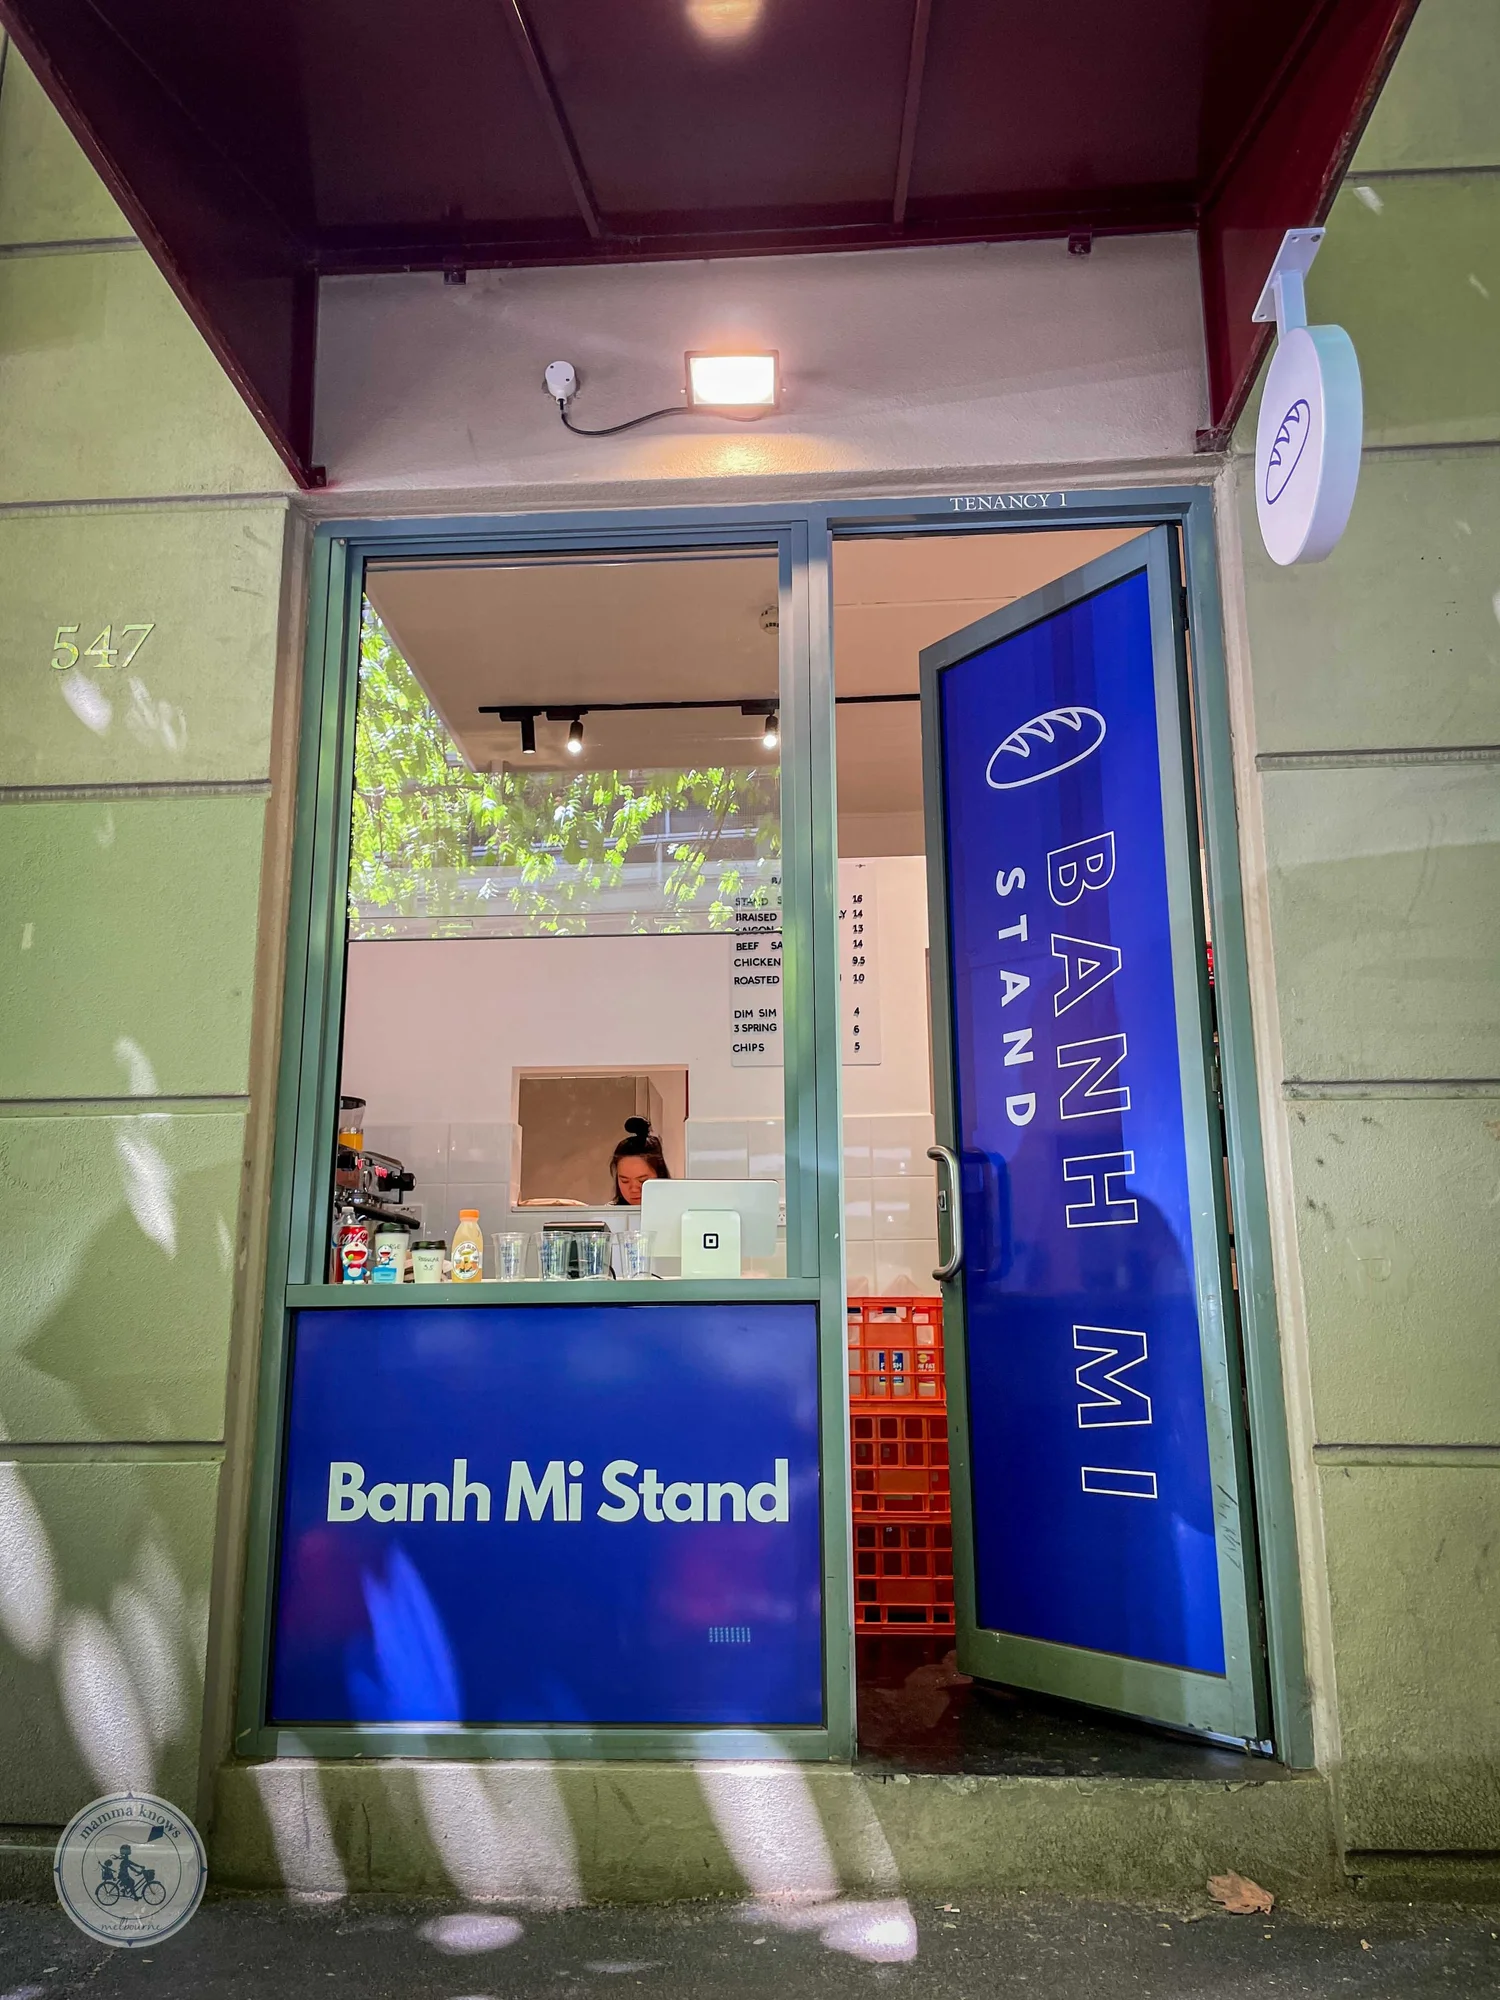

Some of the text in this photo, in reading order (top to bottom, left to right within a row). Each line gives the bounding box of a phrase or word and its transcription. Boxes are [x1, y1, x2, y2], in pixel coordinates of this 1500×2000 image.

[949, 493, 1068, 511] TENANCY 1
[51, 623, 156, 670] 547
[852, 895, 863, 904] 16
[735, 913, 777, 922] BRAISED
[852, 910, 863, 918] 14
[852, 925, 864, 933] 13
[736, 942, 760, 951] BEEF
[853, 940, 863, 948] 14
[733, 956, 866, 967] CHICKEN 9.5
[733, 974, 865, 985] ROASTED 10
[995, 867, 1037, 1127] STAND
[734, 1007, 860, 1019] DIM SIM 4
[733, 1023, 860, 1034] 3 SPRING 6
[732, 1042, 861, 1053] CHIPS 5
[1046, 830, 1158, 1500] BANH MI
[326, 1458, 790, 1523] Banh Mi Stand
